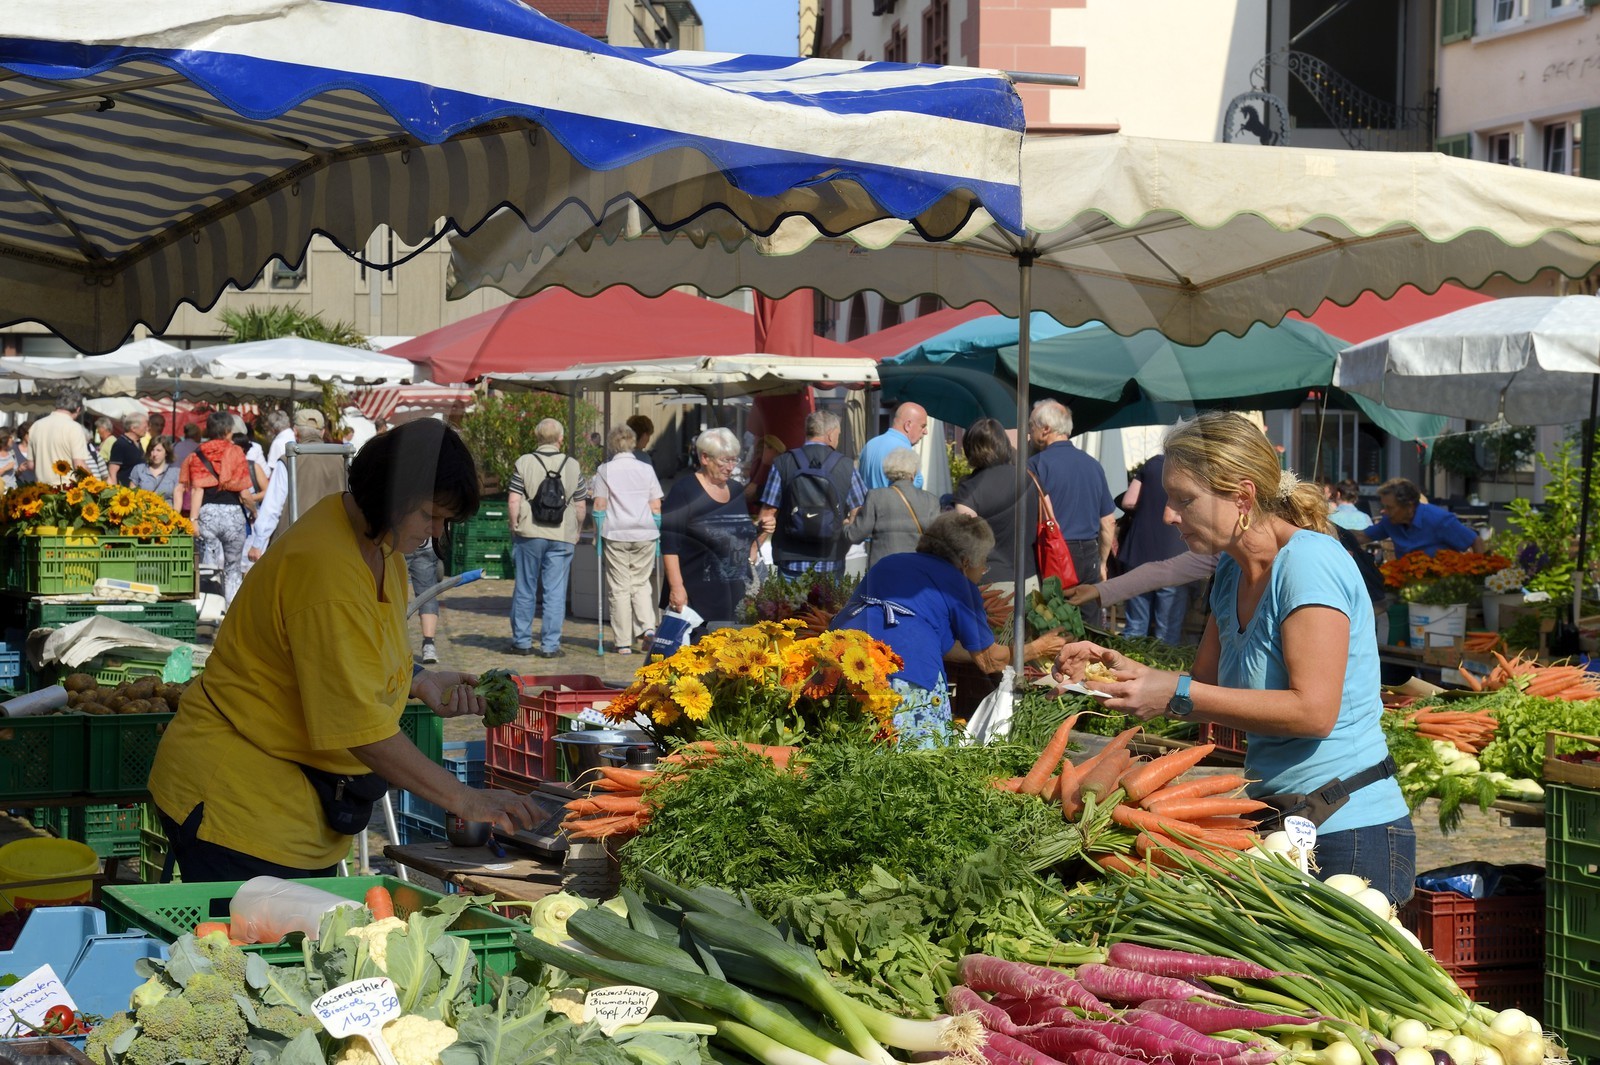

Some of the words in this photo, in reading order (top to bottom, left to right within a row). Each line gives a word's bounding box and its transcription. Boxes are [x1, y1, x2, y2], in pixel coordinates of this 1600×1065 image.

[314, 979, 388, 1010] Kaiserstühler
[591, 988, 654, 997] Kaiserstühler
[589, 997, 650, 1006] Blumenkohl
[595, 1006, 619, 1020] Kopf
